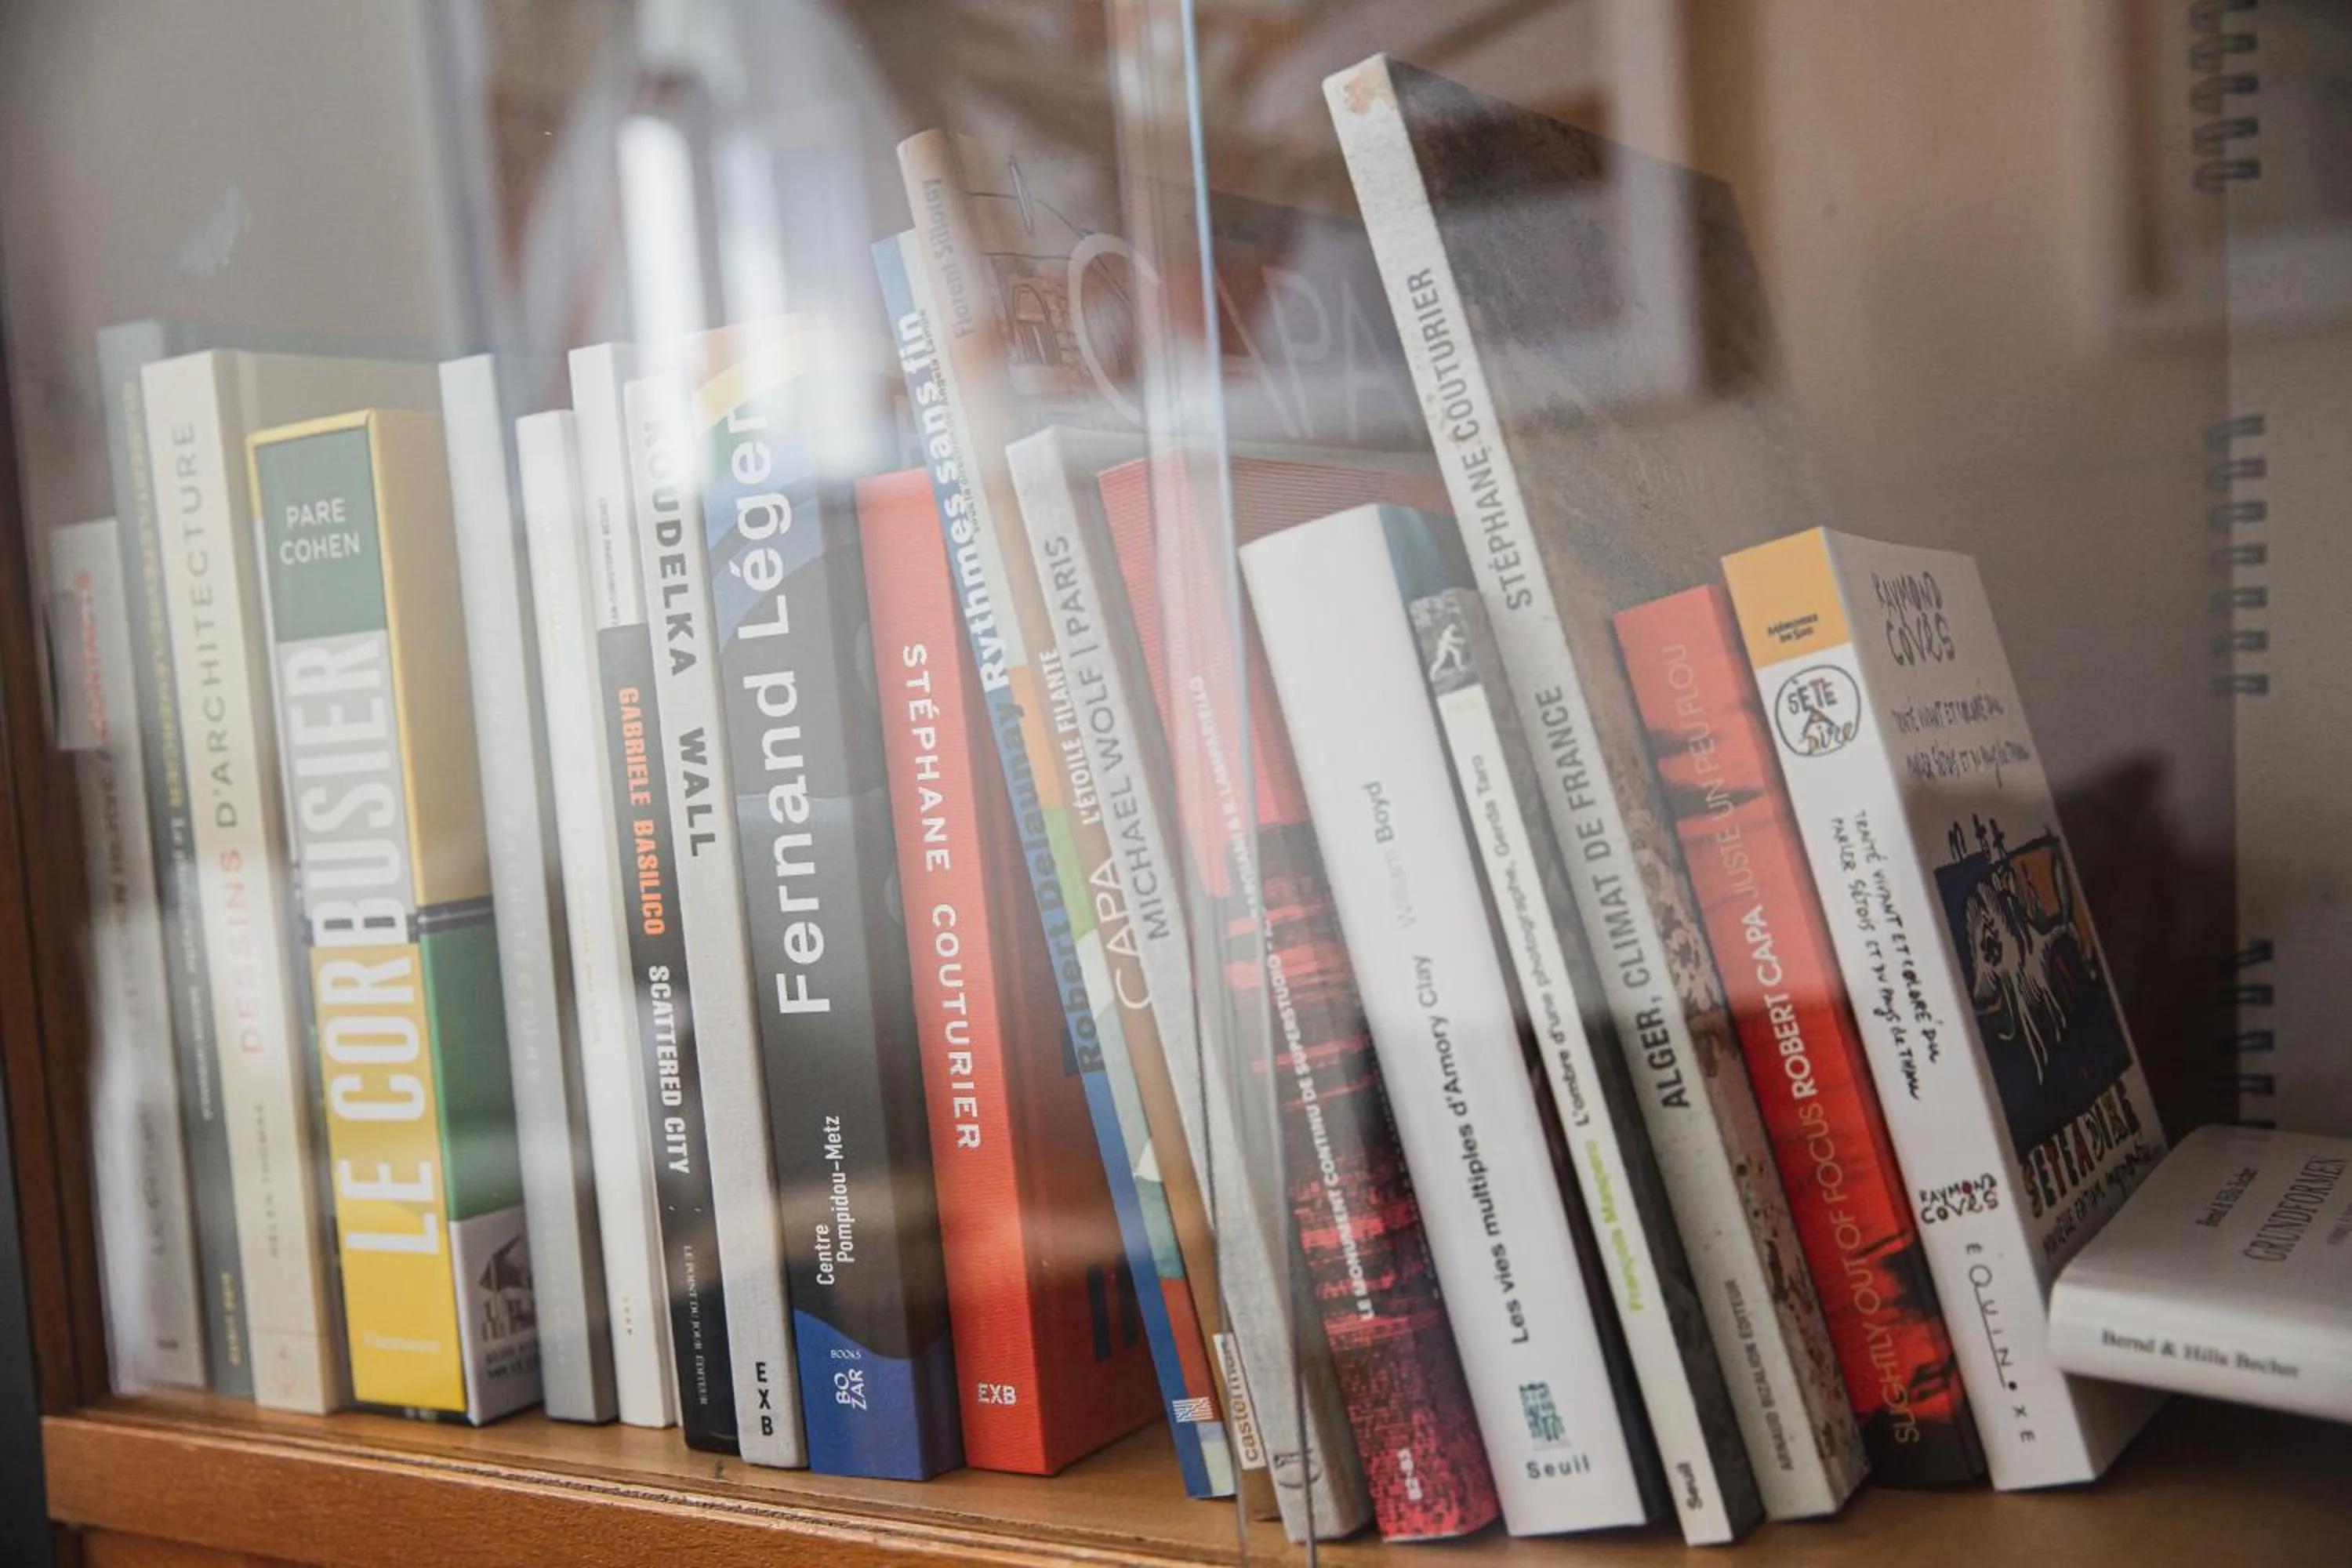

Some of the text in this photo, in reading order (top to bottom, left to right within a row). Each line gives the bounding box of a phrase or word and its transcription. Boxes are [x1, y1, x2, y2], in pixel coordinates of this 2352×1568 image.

[920, 177, 973, 339] Florent Silloray
[916, 307, 938, 354] Lampe
[927, 358, 952, 406] Angela
[1406, 267, 1532, 611] STÉPHANE COUTURIER
[285, 498, 347, 528] PARE
[278, 532, 361, 566] COHEN
[644, 421, 716, 858] KOUDELKA WALL
[726, 403, 831, 1014] Fernand Léger
[898, 312, 1104, 1073] Robert Delaunay Rythmes sans fin
[1044, 535, 1171, 942] MICHAEL WOLF PARIS
[1039, 648, 1150, 1009] CAPA L'ÉTOILE FILANTE
[1853, 808, 1888, 863] TRAITÉ
[285, 637, 427, 1124] CORBUSIER
[902, 643, 981, 1150] STÉPHANE COUTURIER
[1535, 685, 1690, 1109] ALGER, CLIMAT DE FRANCE
[1872, 868, 1904, 931] VIVANT
[220, 848, 263, 1054] DESSINS
[618, 686, 690, 1174] GABRIELE BASILICO SCATTERED CITY
[1891, 934, 1911, 957] ET
[1268, 955, 1309, 1080] SUPERSTUDIO
[1900, 958, 1944, 1027] COLORÉ
[1359, 779, 1530, 1346] Les vies multiples d'Amory Clay Boyd
[1469, 753, 1642, 1312] François Maspero L'ombre d'une photographe, Gerda Taro
[1662, 644, 1922, 1447] SLIGHTLY OUT OF FOCUS ROBERT CAPA JUSTE UN PEU FLOU
[1298, 1076, 1317, 1102] DE
[1305, 1105, 1339, 1187] CONTINU
[338, 1158, 441, 1255] LE
[824, 1113, 856, 1263] Pompidou-Metz
[1920, 1173, 1998, 1204] RAYMOND
[2242, 1155, 2349, 1262] GRUNDFORMEN
[682, 1245, 693, 1258] LE
[684, 1261, 699, 1298] POINT
[816, 1223, 836, 1286] Centre
[689, 1301, 699, 1318] DU
[691, 1319, 704, 1349] JOUR
[1358, 1297, 1376, 1319] LE
[830, 1349, 862, 1359] BOOKS
[2101, 1328, 2156, 1354] Bernd
[2160, 1338, 2177, 1359] &
[2235, 1350, 2299, 1380] Becher
[834, 1373, 851, 1404] BO
[848, 1369, 866, 1410] ZAR
[978, 1383, 1015, 1405] EXB
[1331, 1343, 1368, 1453] MONUMENT
[1526, 1451, 1591, 1480] Seuil
[1675, 1461, 1703, 1512] Seuil
